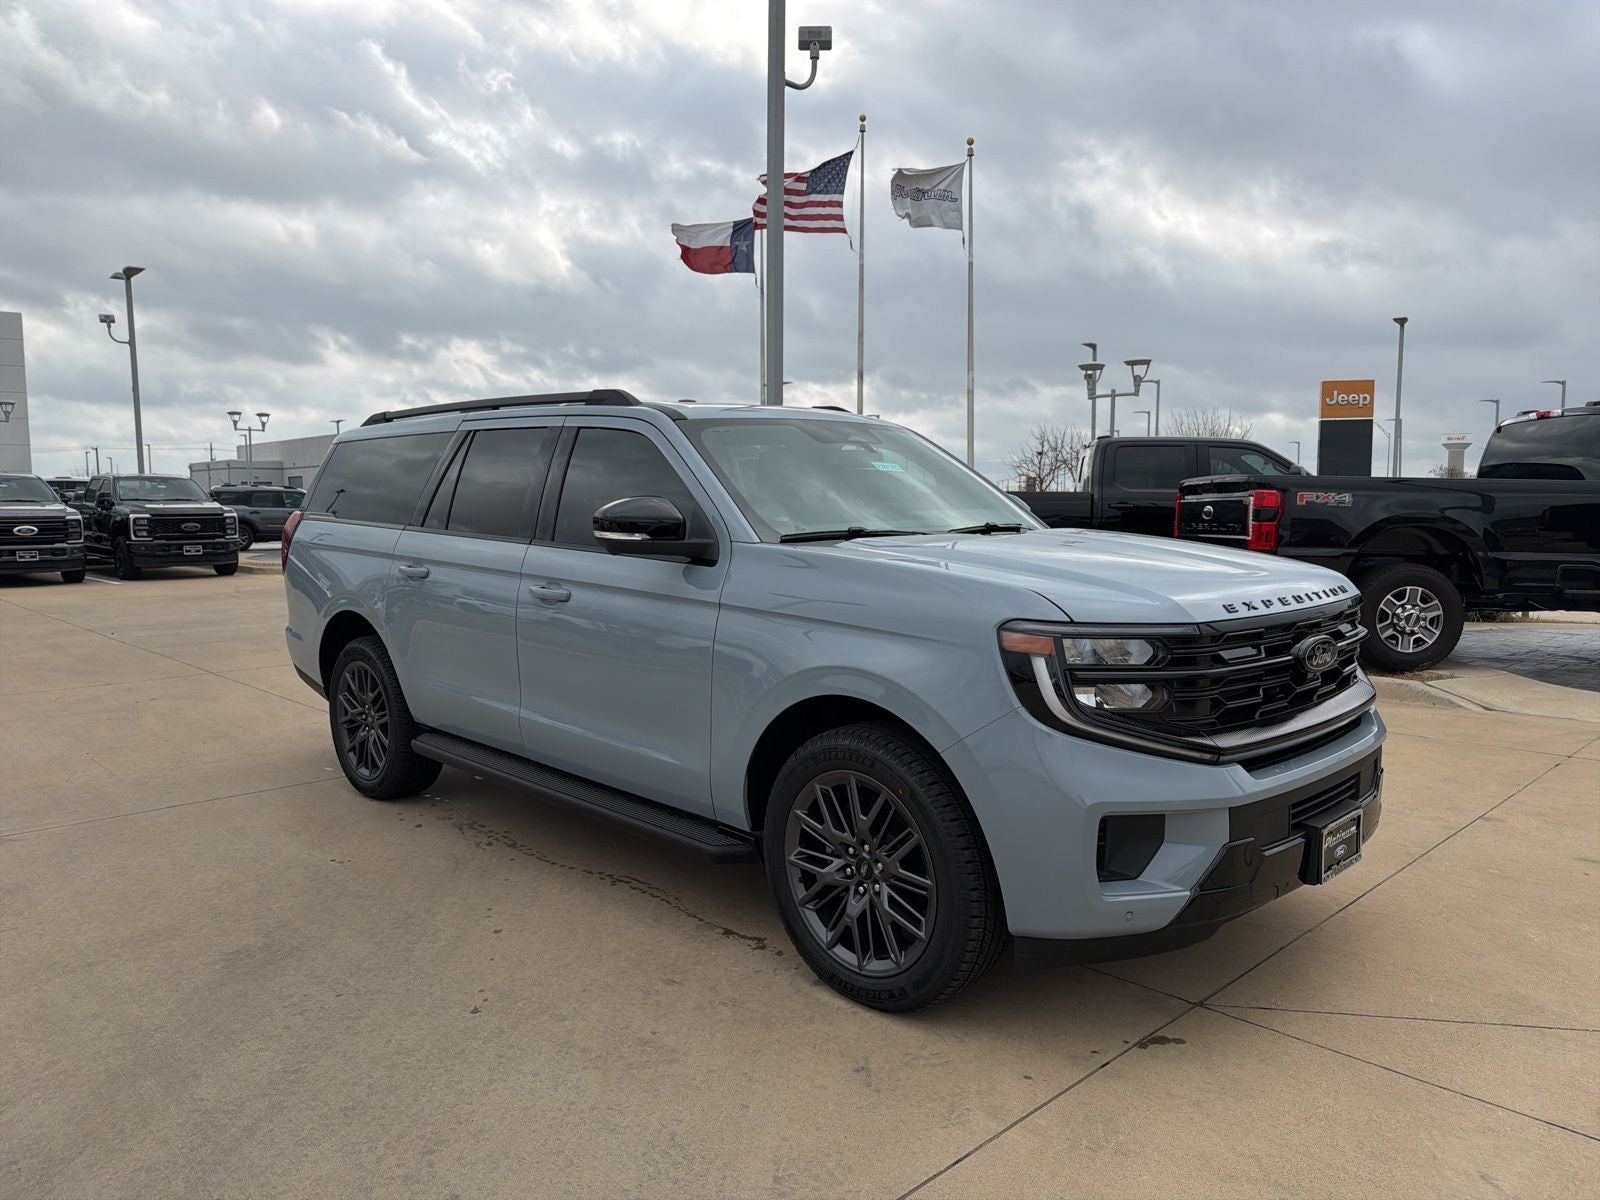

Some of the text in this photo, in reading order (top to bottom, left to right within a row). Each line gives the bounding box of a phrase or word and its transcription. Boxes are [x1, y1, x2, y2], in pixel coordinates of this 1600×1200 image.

[1326, 390, 1370, 407] Jeep
[1297, 492, 1350, 506] FX4
[1222, 584, 1349, 614] EXPEDITION
[1312, 643, 1333, 666] Ford
